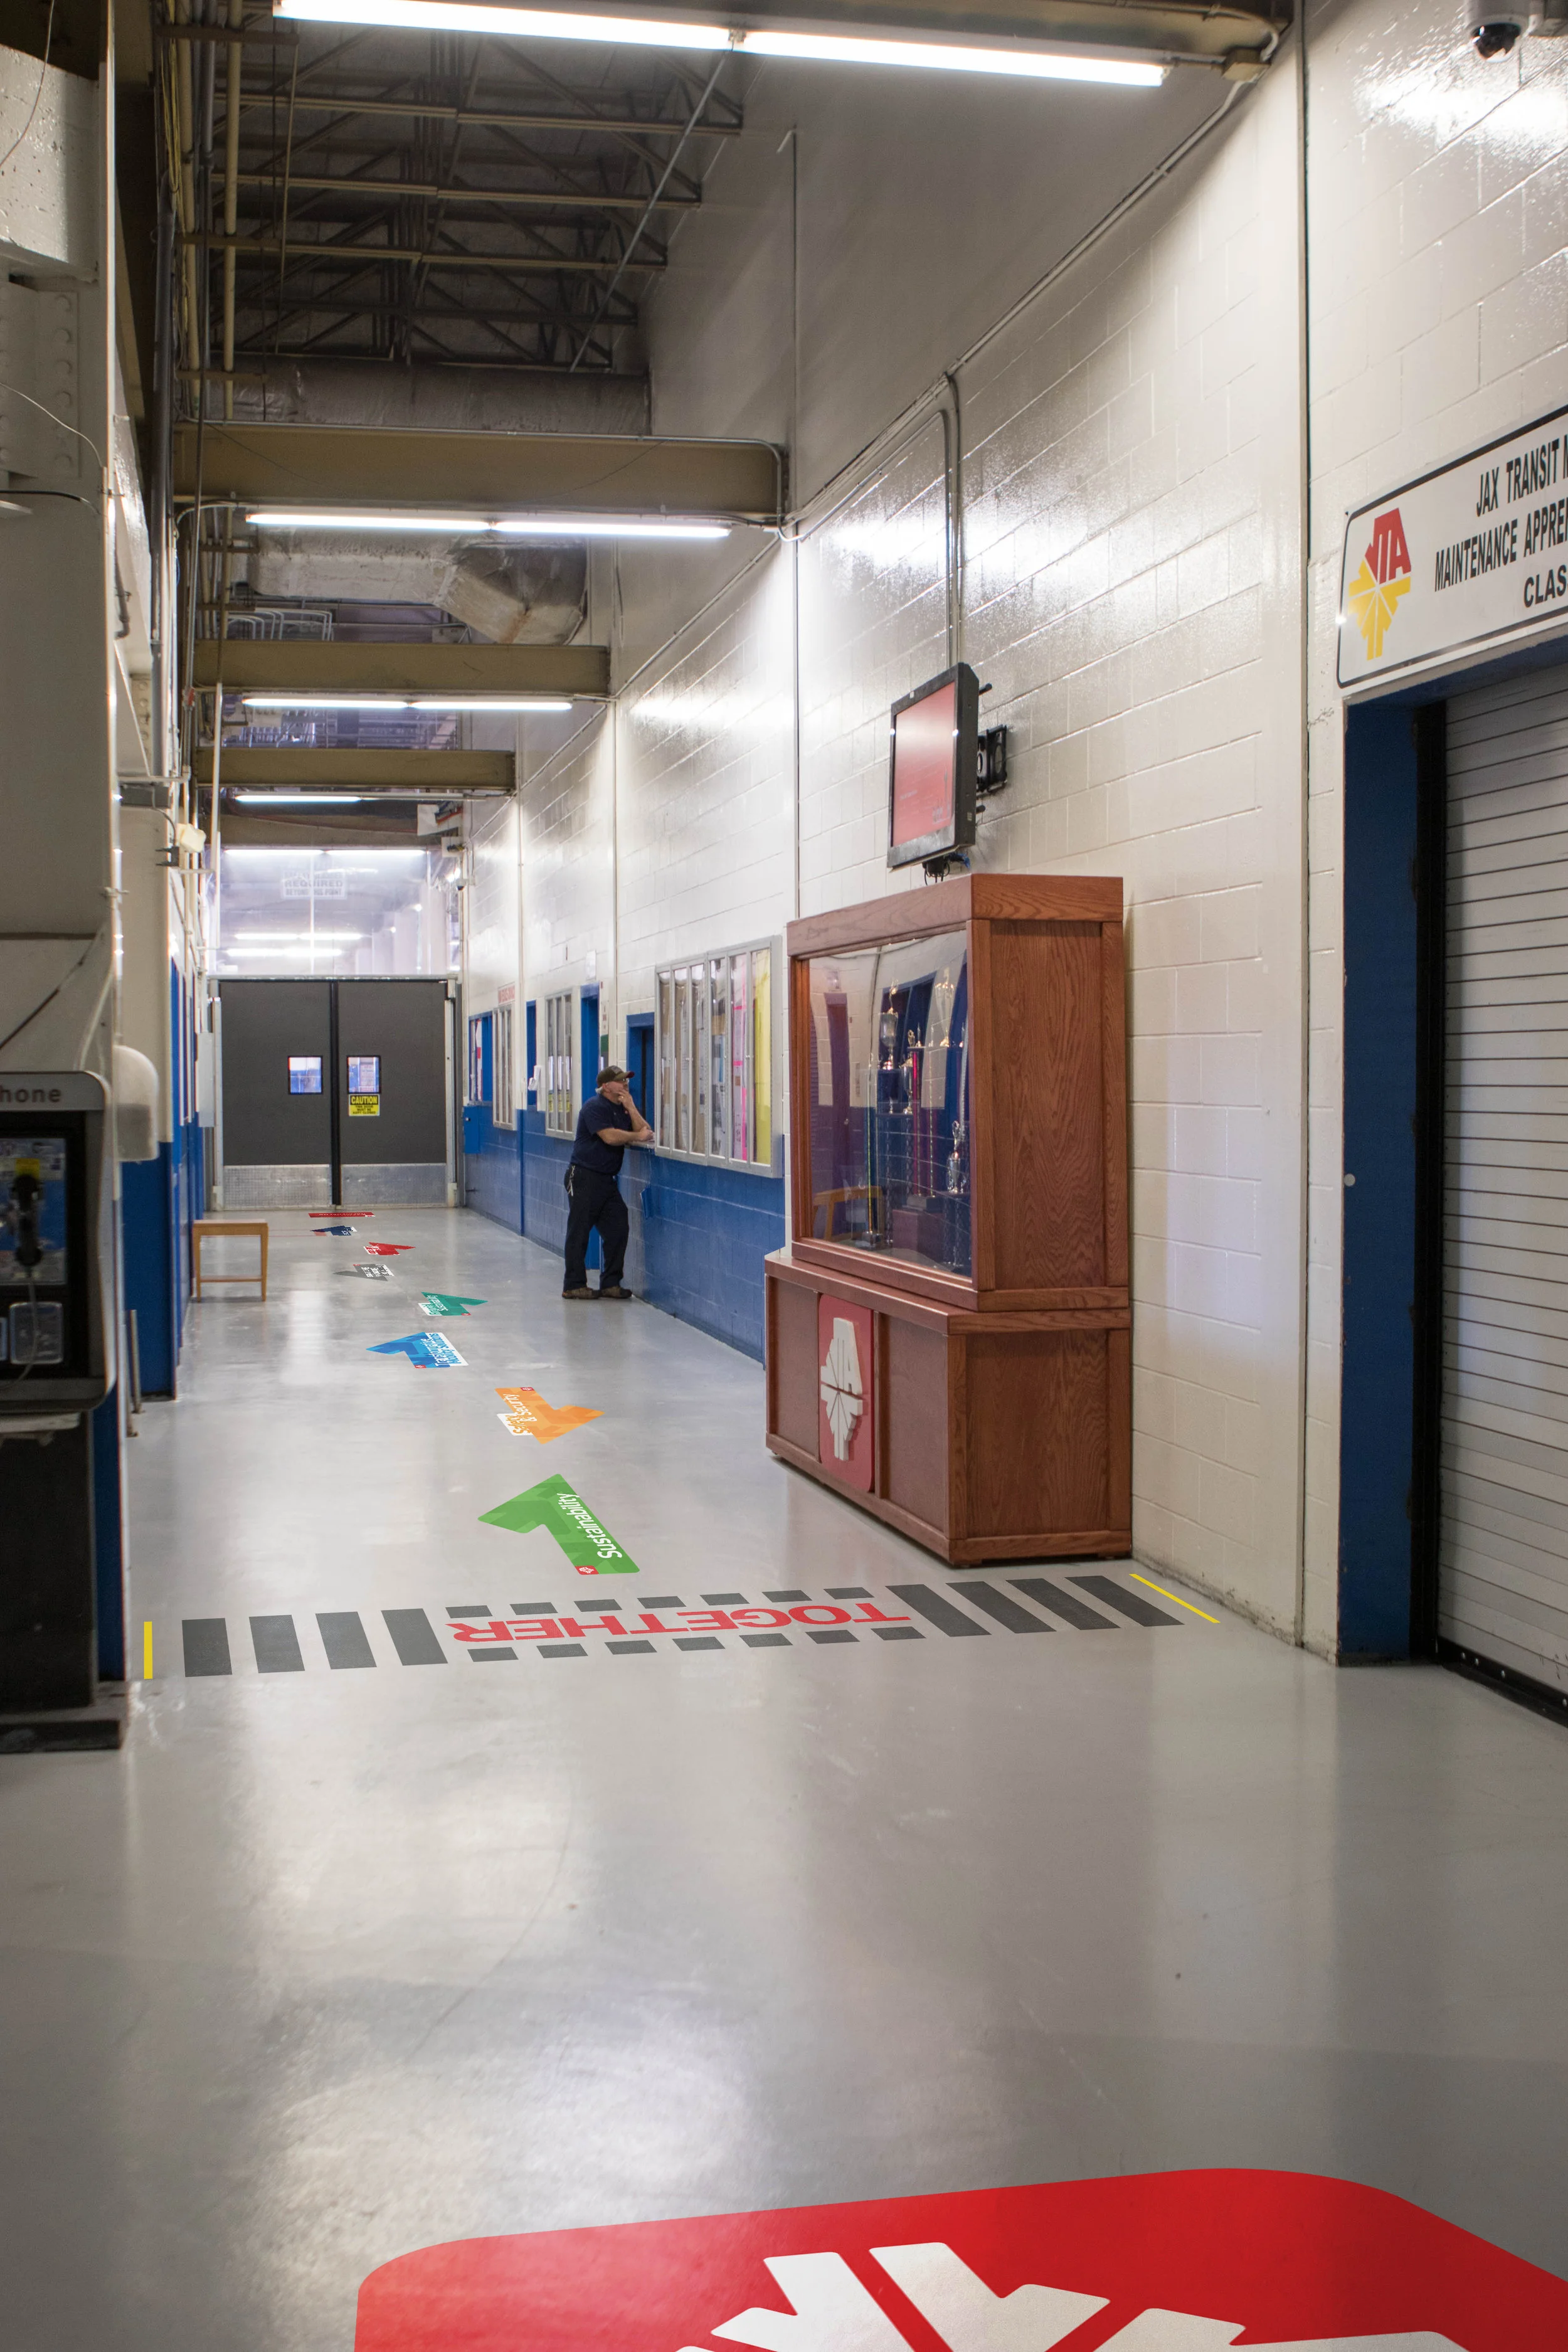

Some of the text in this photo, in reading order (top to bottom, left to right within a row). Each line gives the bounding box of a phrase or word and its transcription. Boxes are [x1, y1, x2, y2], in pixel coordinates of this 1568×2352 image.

[1476, 467, 1499, 517] JAX
[1506, 438, 1559, 503] TRANSIT
[1434, 497, 1568, 592] MAINTENANCE APPRE
[1523, 564, 1568, 608] CLAS
[351, 1096, 378, 1104] CAUTION
[502, 1394, 532, 1415] Security
[505, 1414, 531, 1434] Safety
[557, 1493, 622, 1559] Sustainability
[445, 1603, 911, 1642] TOGETHER
